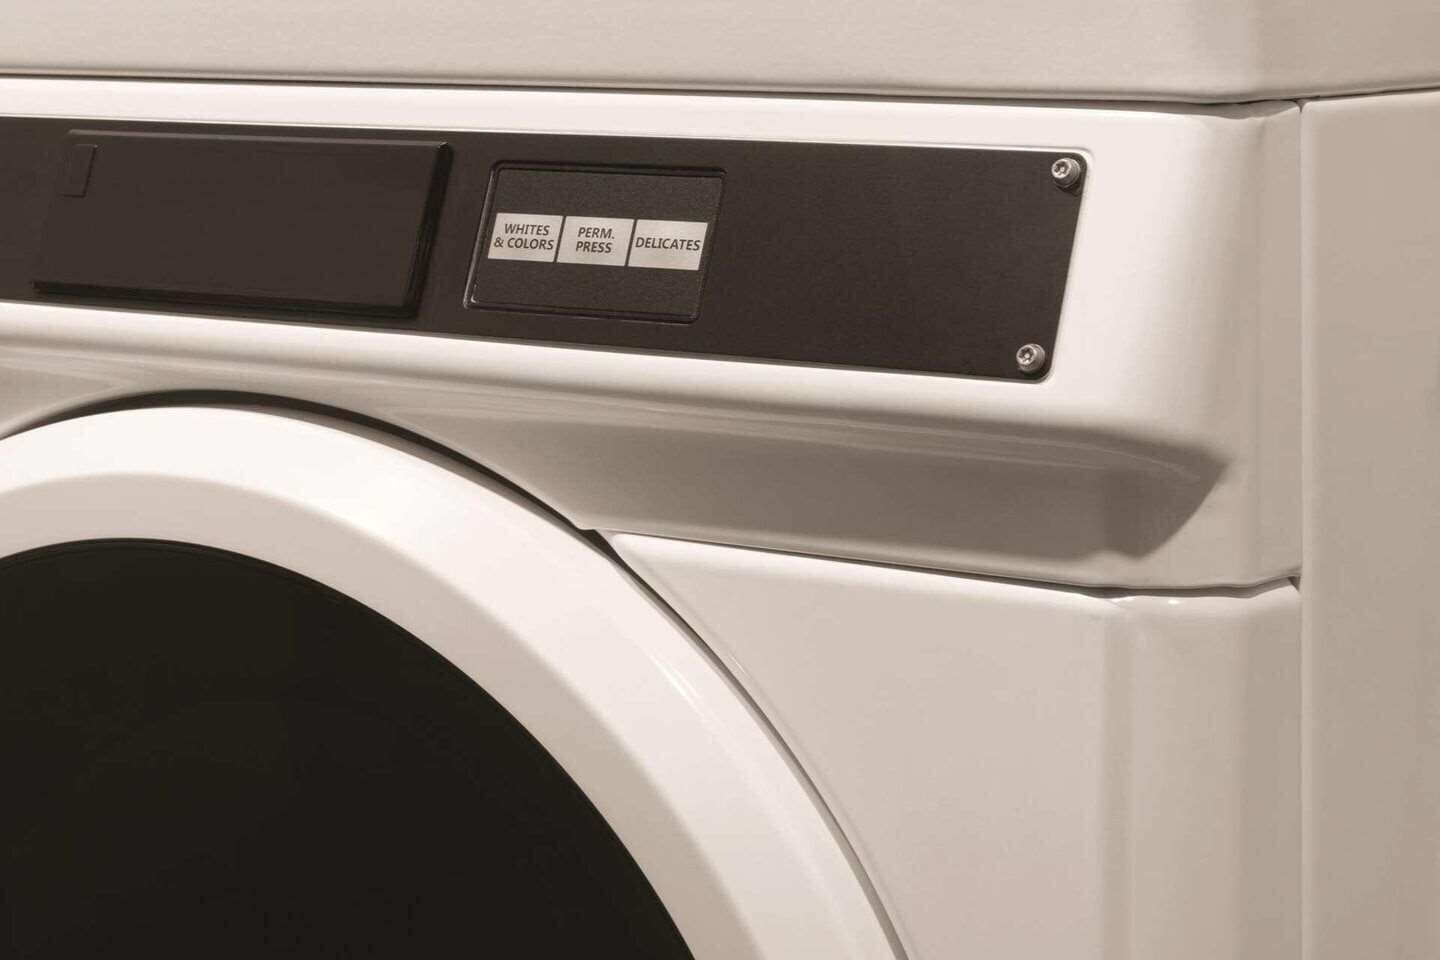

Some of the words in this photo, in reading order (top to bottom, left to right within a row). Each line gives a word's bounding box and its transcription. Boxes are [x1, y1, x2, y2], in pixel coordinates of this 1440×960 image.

[504, 223, 551, 237] WHITES
[577, 226, 615, 240] PERM.
[493, 237, 504, 249] &
[507, 237, 555, 251] COLORS
[575, 241, 612, 254] PRESS
[635, 236, 701, 252] DELICATES
